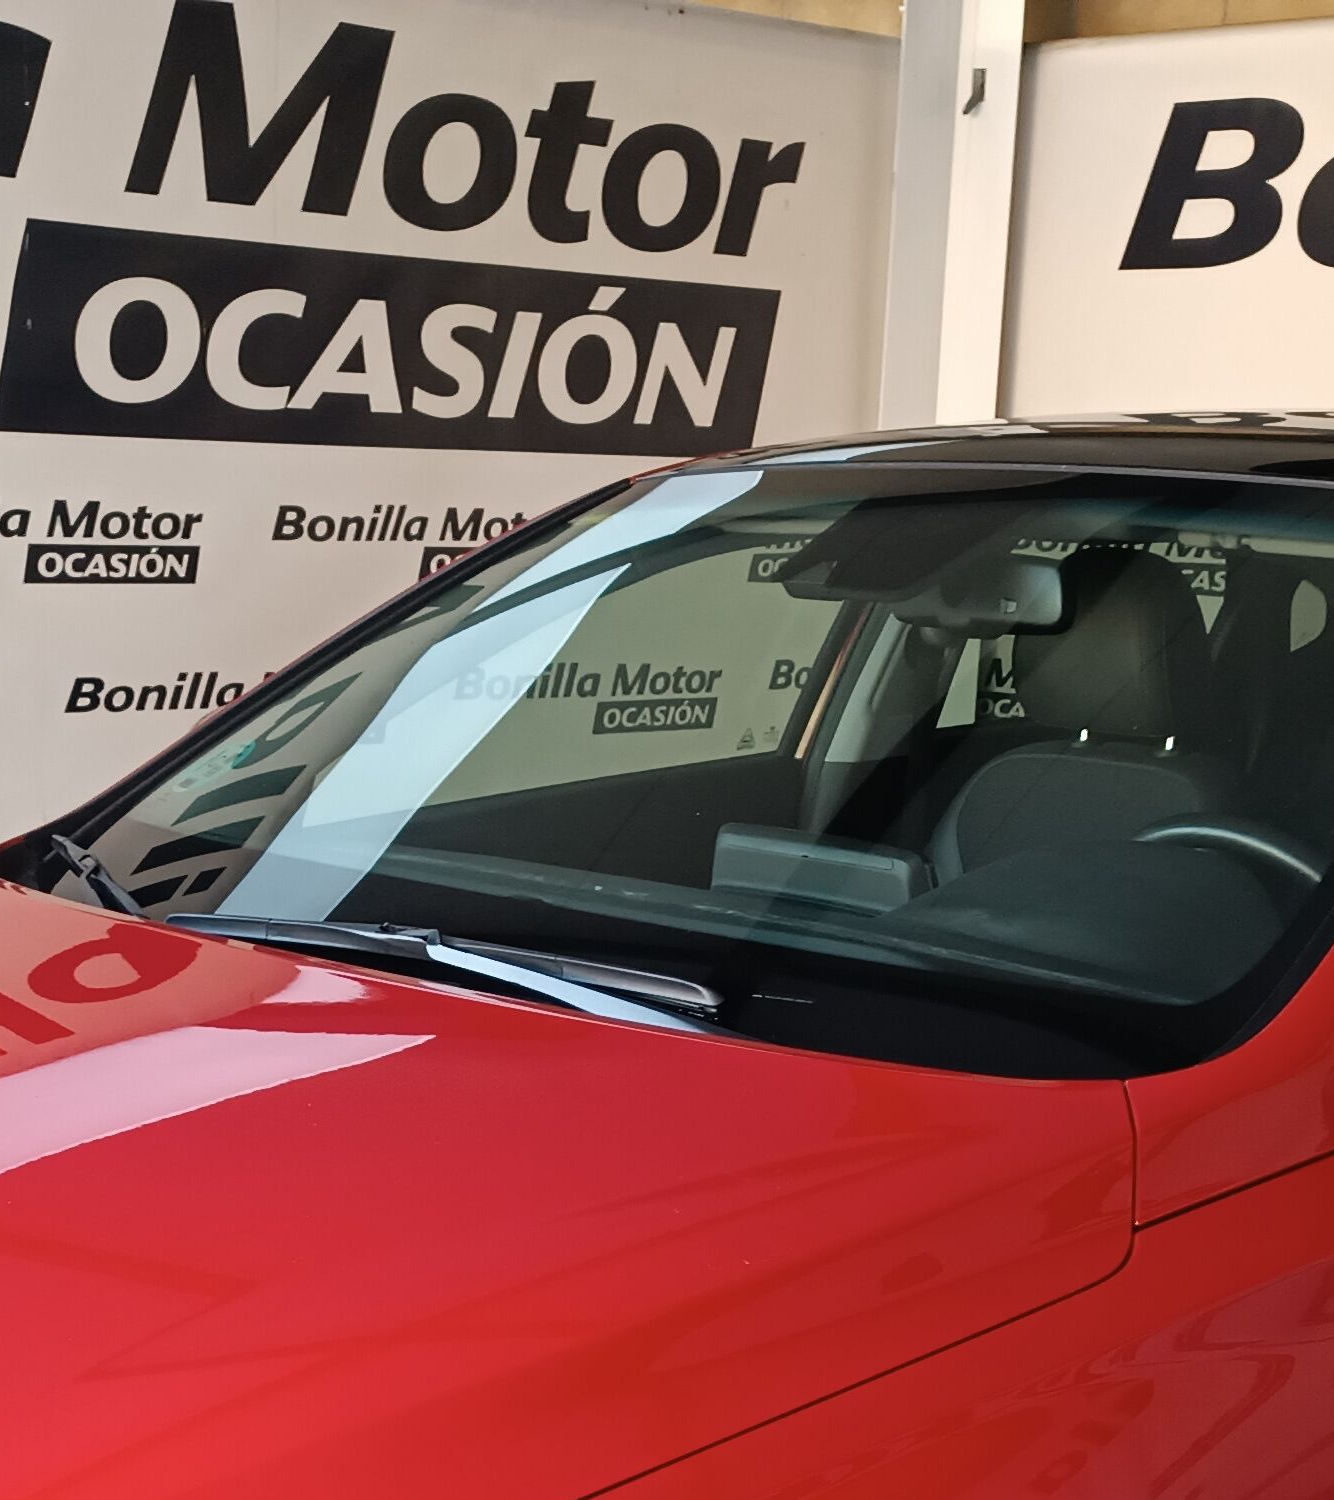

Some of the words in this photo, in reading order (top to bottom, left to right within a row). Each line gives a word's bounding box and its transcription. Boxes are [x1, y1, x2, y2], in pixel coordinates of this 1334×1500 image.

[125, 0, 805, 257] Motor
[74, 277, 738, 428] OCASIÓN
[46, 500, 203, 541] Motor
[271, 504, 429, 542] Bonilla
[37, 548, 186, 580] OCASIÓN
[64, 672, 245, 713] Bonilla
[454, 662, 602, 700] Bonilla
[611, 663, 723, 697] Motor
[602, 701, 711, 728] OCASIÓN
